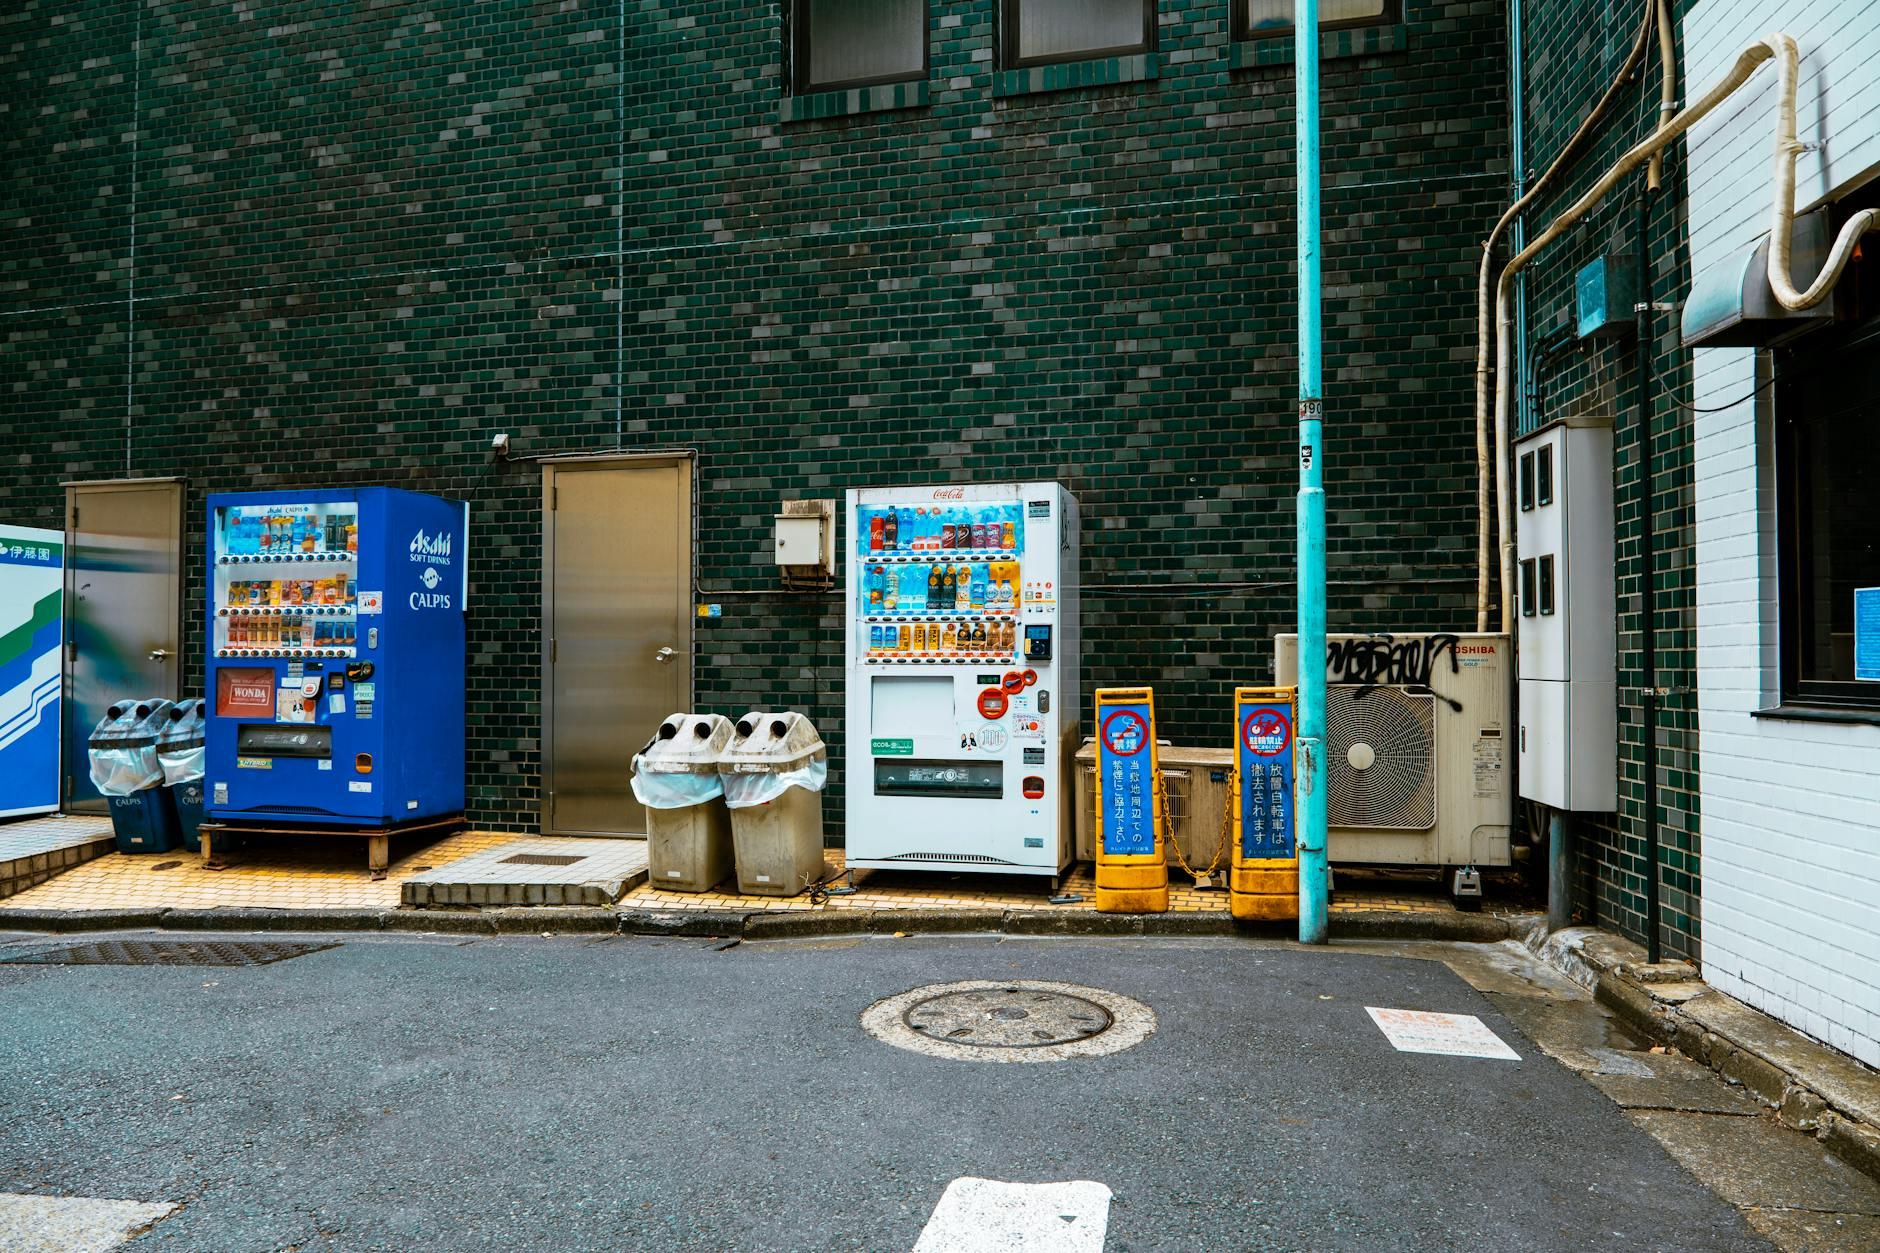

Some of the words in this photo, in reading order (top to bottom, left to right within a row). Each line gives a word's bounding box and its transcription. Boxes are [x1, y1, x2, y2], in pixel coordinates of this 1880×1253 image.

[409, 528, 450, 557] Asahi
[9, 545, 50, 561] 伊藤園
[410, 553, 426, 563] SOFT
[427, 556, 450, 566] DRINKS
[409, 592, 450, 611] CALPIS
[1446, 646, 1495, 654] TOSHIBA
[234, 687, 266, 698] WONDA
[115, 797, 142, 807] CALPIS
[1251, 763, 1266, 845] 撤去されます
[1269, 764, 1285, 844] 放置自転車は
